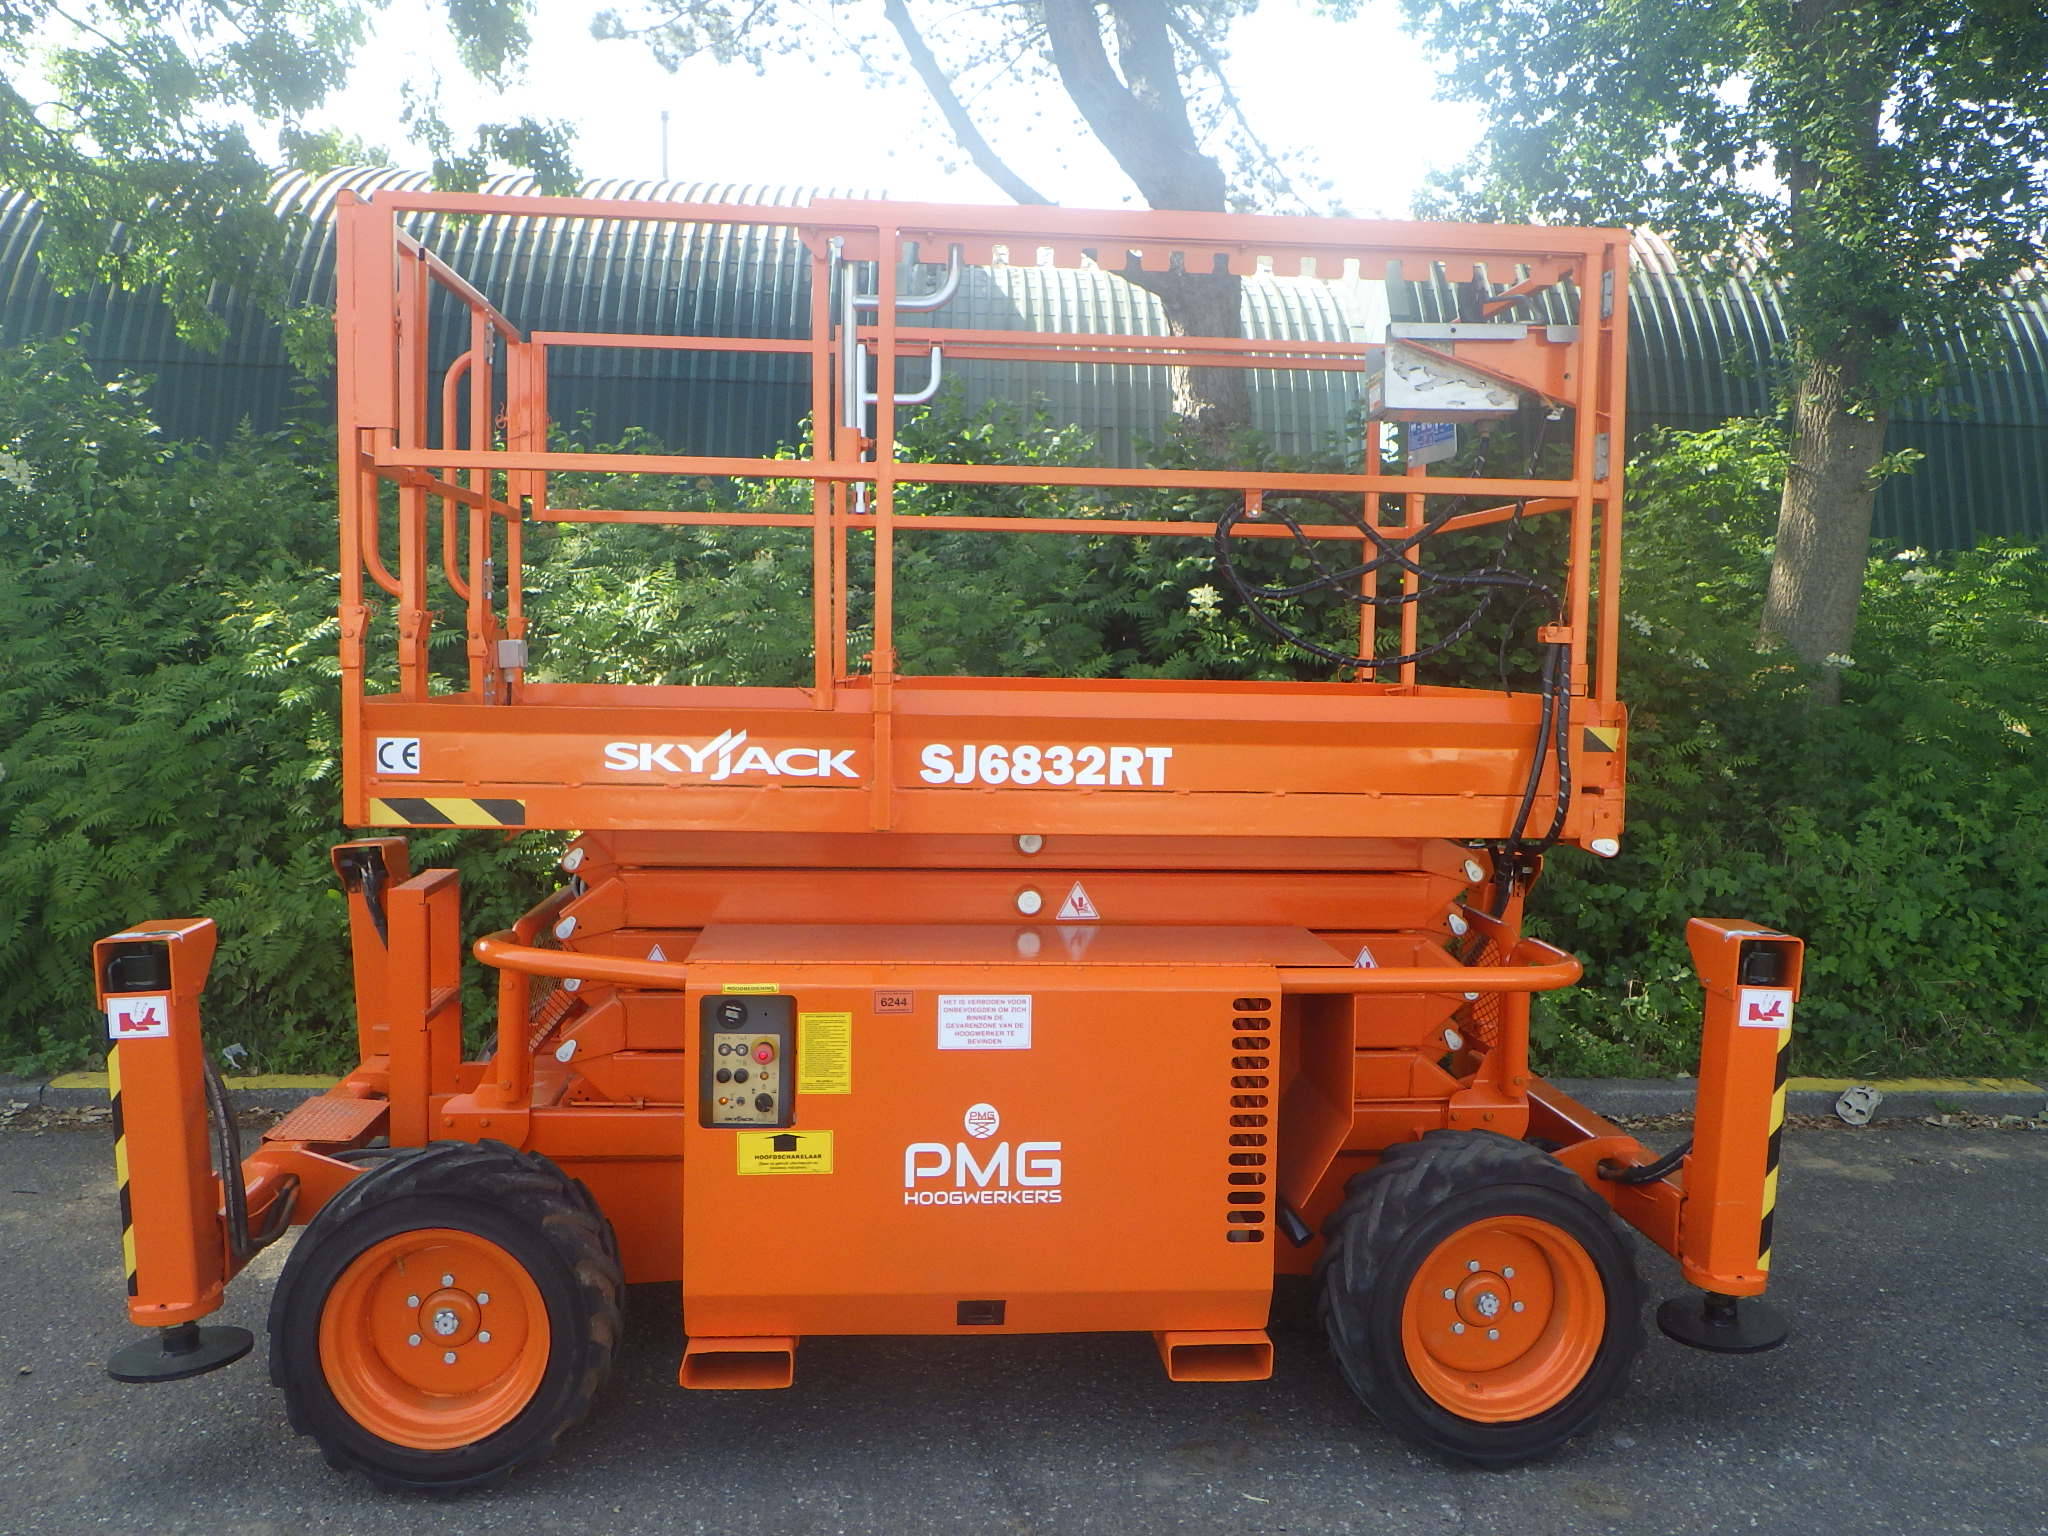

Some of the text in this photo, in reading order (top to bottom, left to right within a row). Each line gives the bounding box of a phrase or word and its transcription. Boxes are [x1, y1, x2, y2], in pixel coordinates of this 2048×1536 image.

[604, 729, 860, 780] SKYJACK
[919, 743, 1173, 786] SJ6832RT
[880, 997, 907, 1007] 6244
[969, 1111, 995, 1120] PMG
[905, 1141, 1062, 1188] PMG
[904, 1189, 1062, 1205] HOOGWERKERS
